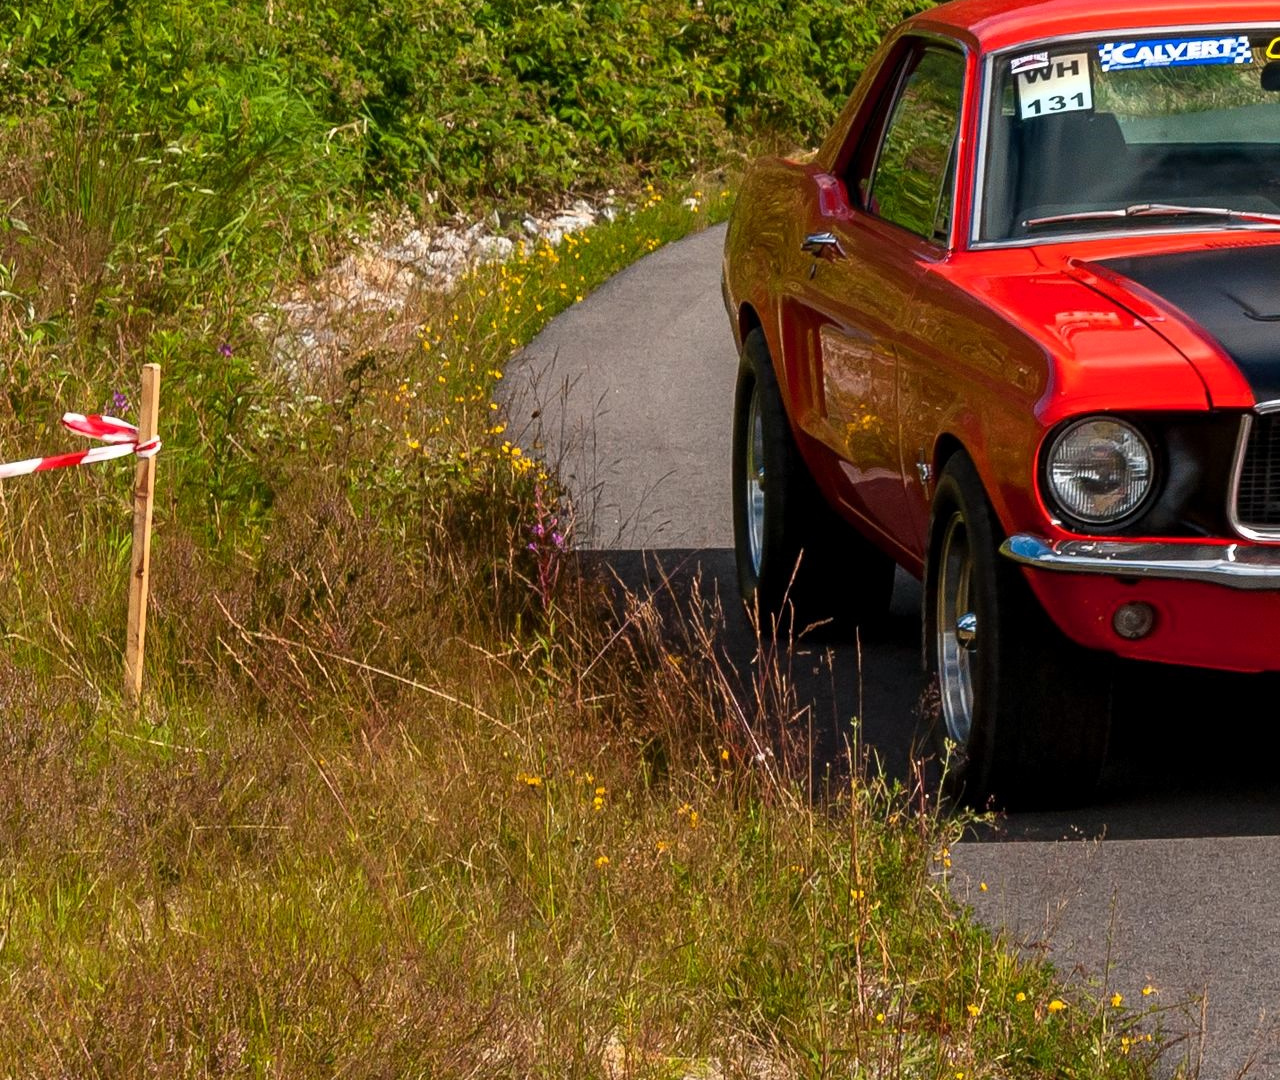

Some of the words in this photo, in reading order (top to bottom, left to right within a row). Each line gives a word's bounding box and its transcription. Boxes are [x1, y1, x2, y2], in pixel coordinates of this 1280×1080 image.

[1111, 38, 1236, 64] CALVERT
[1023, 60, 1079, 84] WH
[1028, 92, 1084, 114] 131
